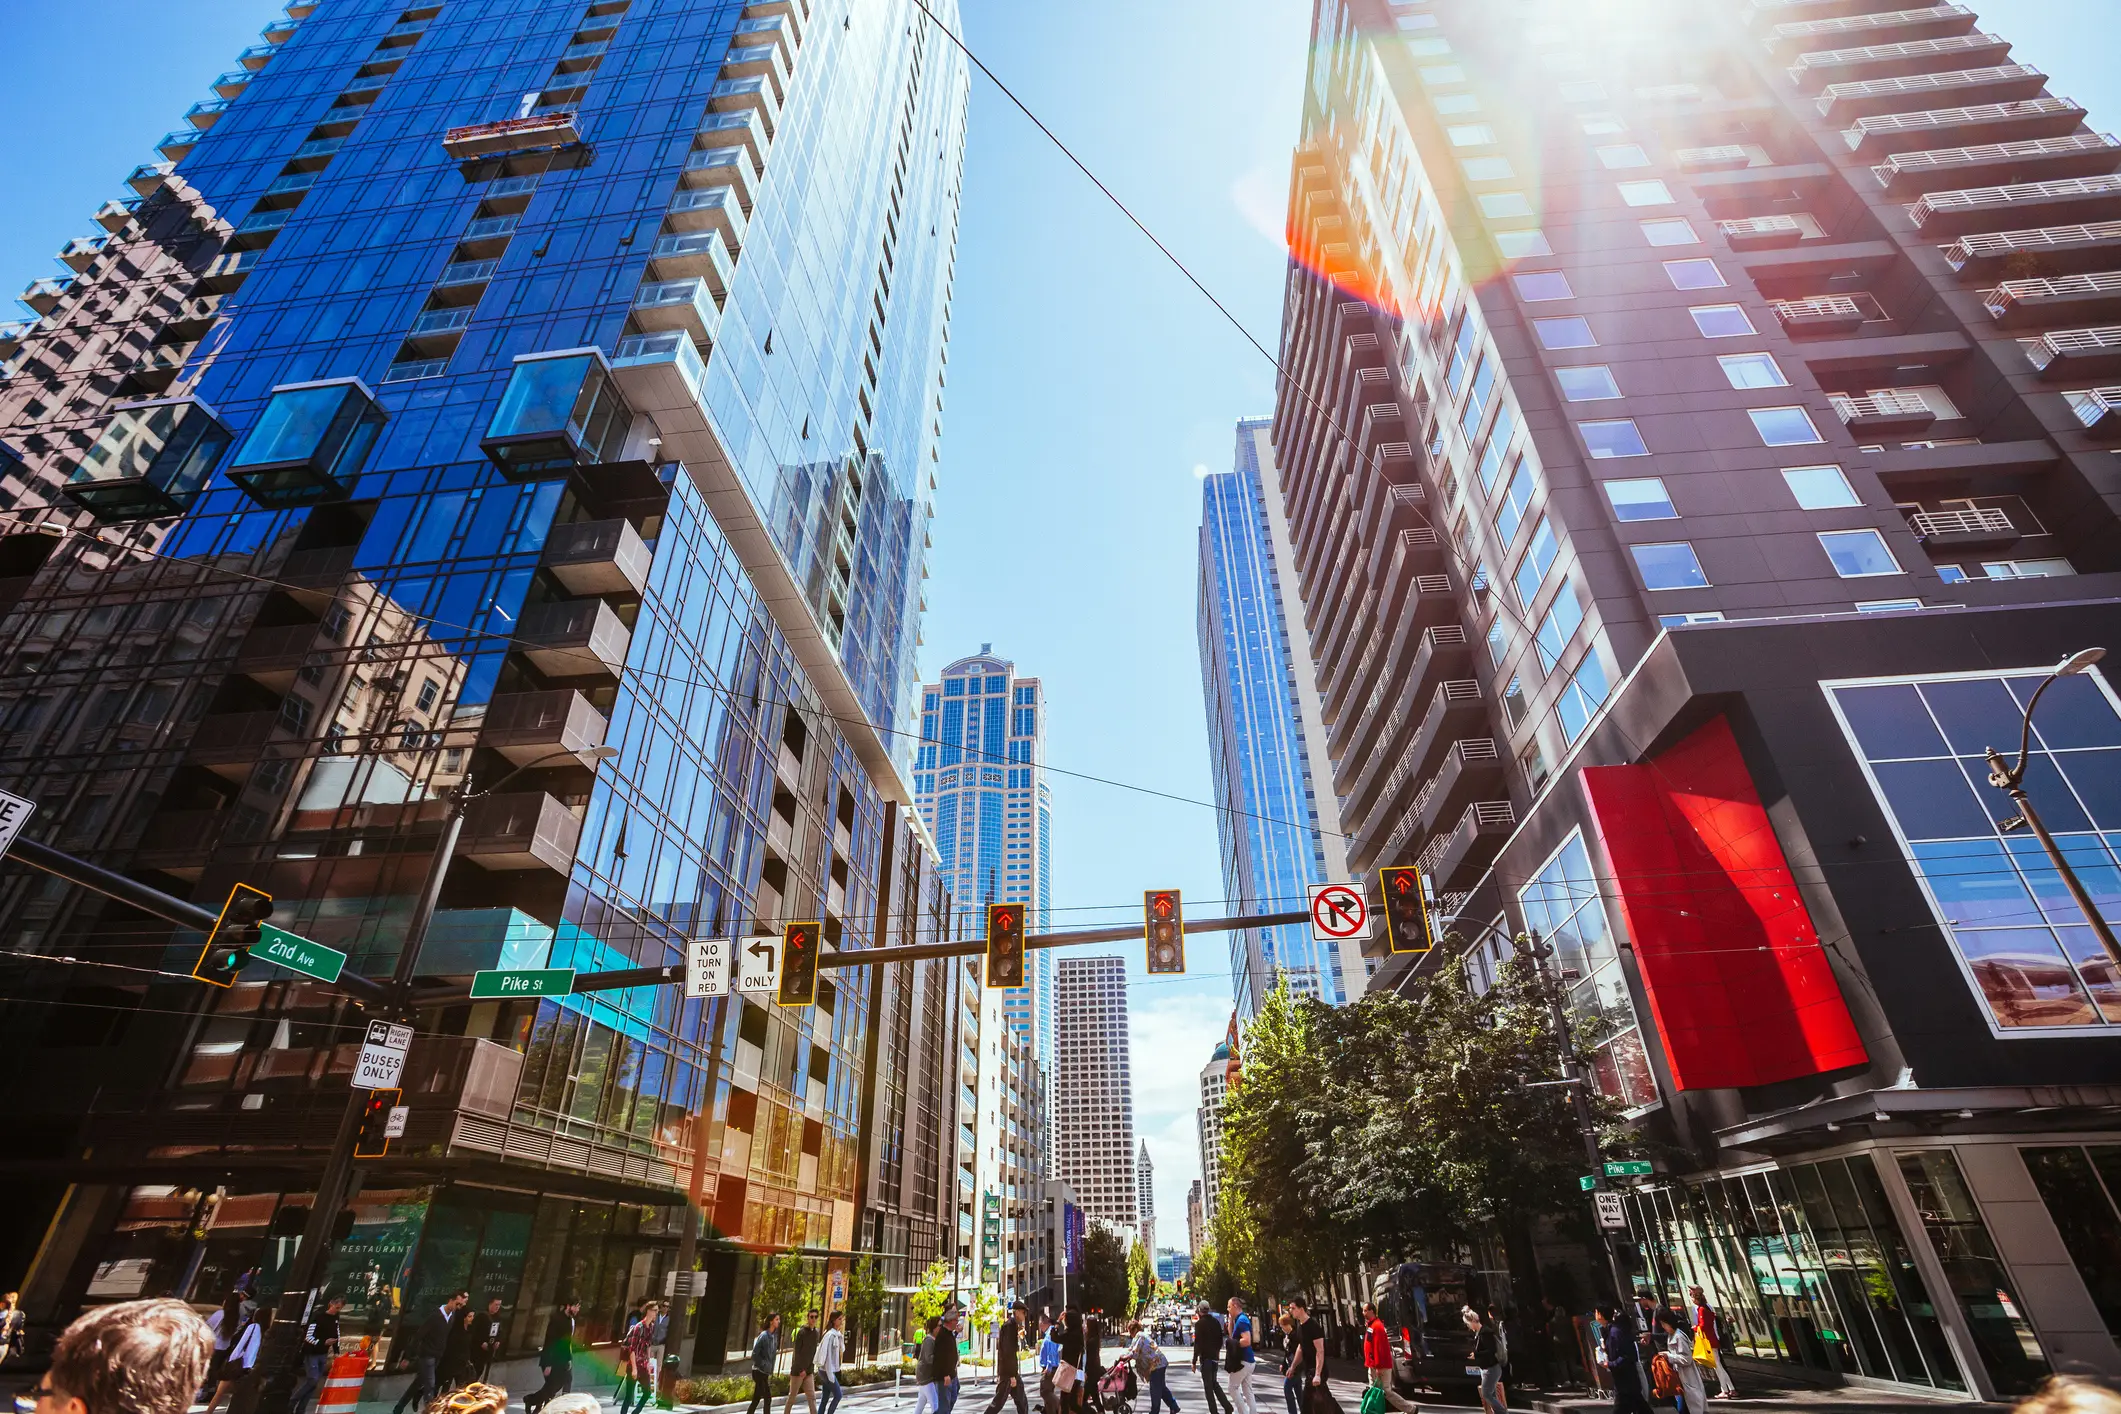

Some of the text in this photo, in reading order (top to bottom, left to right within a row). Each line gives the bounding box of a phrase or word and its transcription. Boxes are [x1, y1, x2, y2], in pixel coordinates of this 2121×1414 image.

[268, 937, 315, 967] 2nd Ave
[700, 944, 718, 956] NO
[697, 958, 722, 968] TURN
[702, 970, 715, 980] ON
[500, 976, 544, 991] Pike St
[745, 975, 775, 988] ONLY
[698, 983, 717, 993] RED
[390, 1027, 410, 1039] RIGHT
[389, 1037, 407, 1046] LANE
[362, 1052, 401, 1069] BUSES
[363, 1065, 394, 1080] ONLY
[1607, 1164, 1625, 1174] Pike
[1633, 1165, 1640, 1173] St
[1598, 1195, 1618, 1204] ONE
[1600, 1204, 1619, 1213] WAY
[340, 1245, 412, 1253] RESTAURANT
[481, 1248, 523, 1256] RESTAURANT
[348, 1272, 386, 1280] RETAL
[346, 1286, 381, 1294] SPAE
